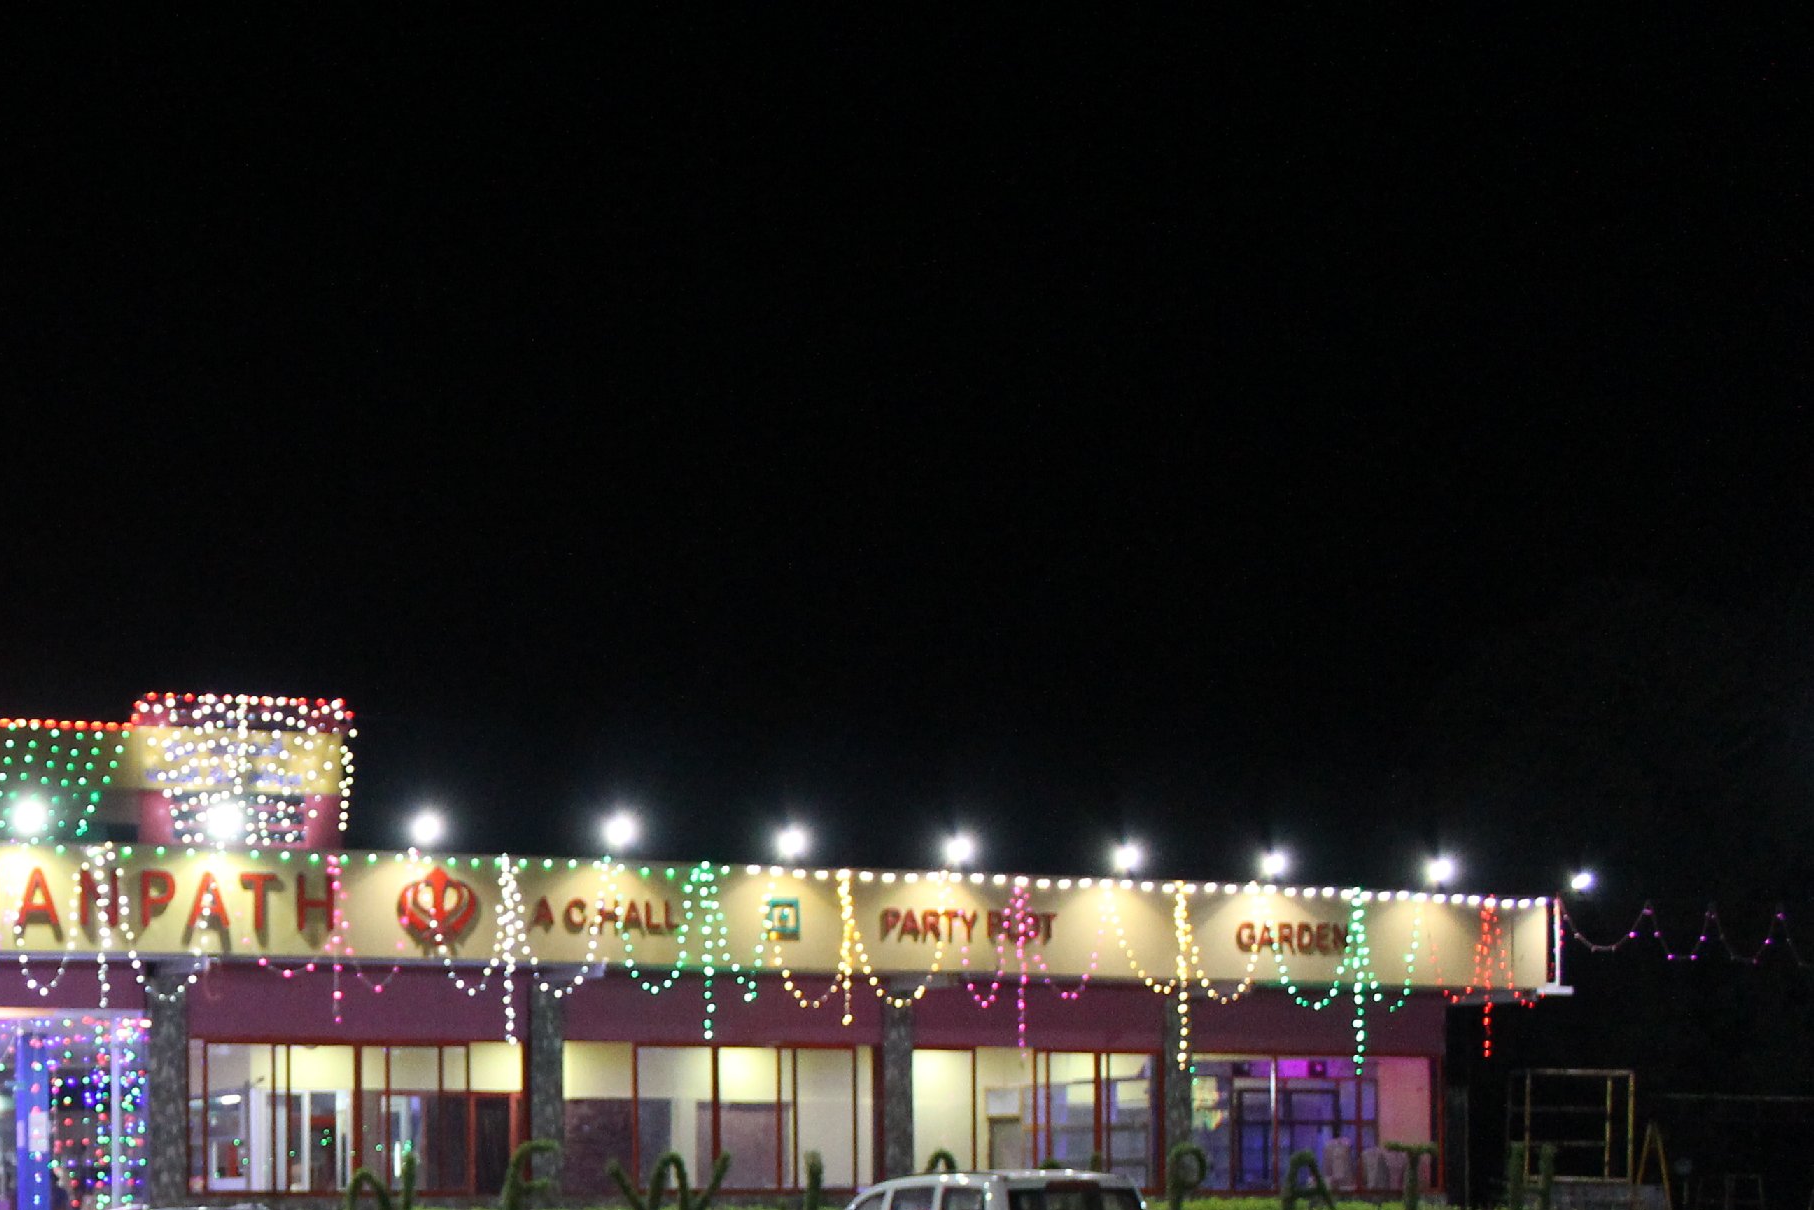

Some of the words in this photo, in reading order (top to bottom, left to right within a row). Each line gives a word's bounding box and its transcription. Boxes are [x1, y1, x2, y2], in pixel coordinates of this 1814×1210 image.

[597, 899, 680, 937] HALL
[879, 908, 978, 943] PARTY
[1236, 921, 1350, 955] GARDEN
